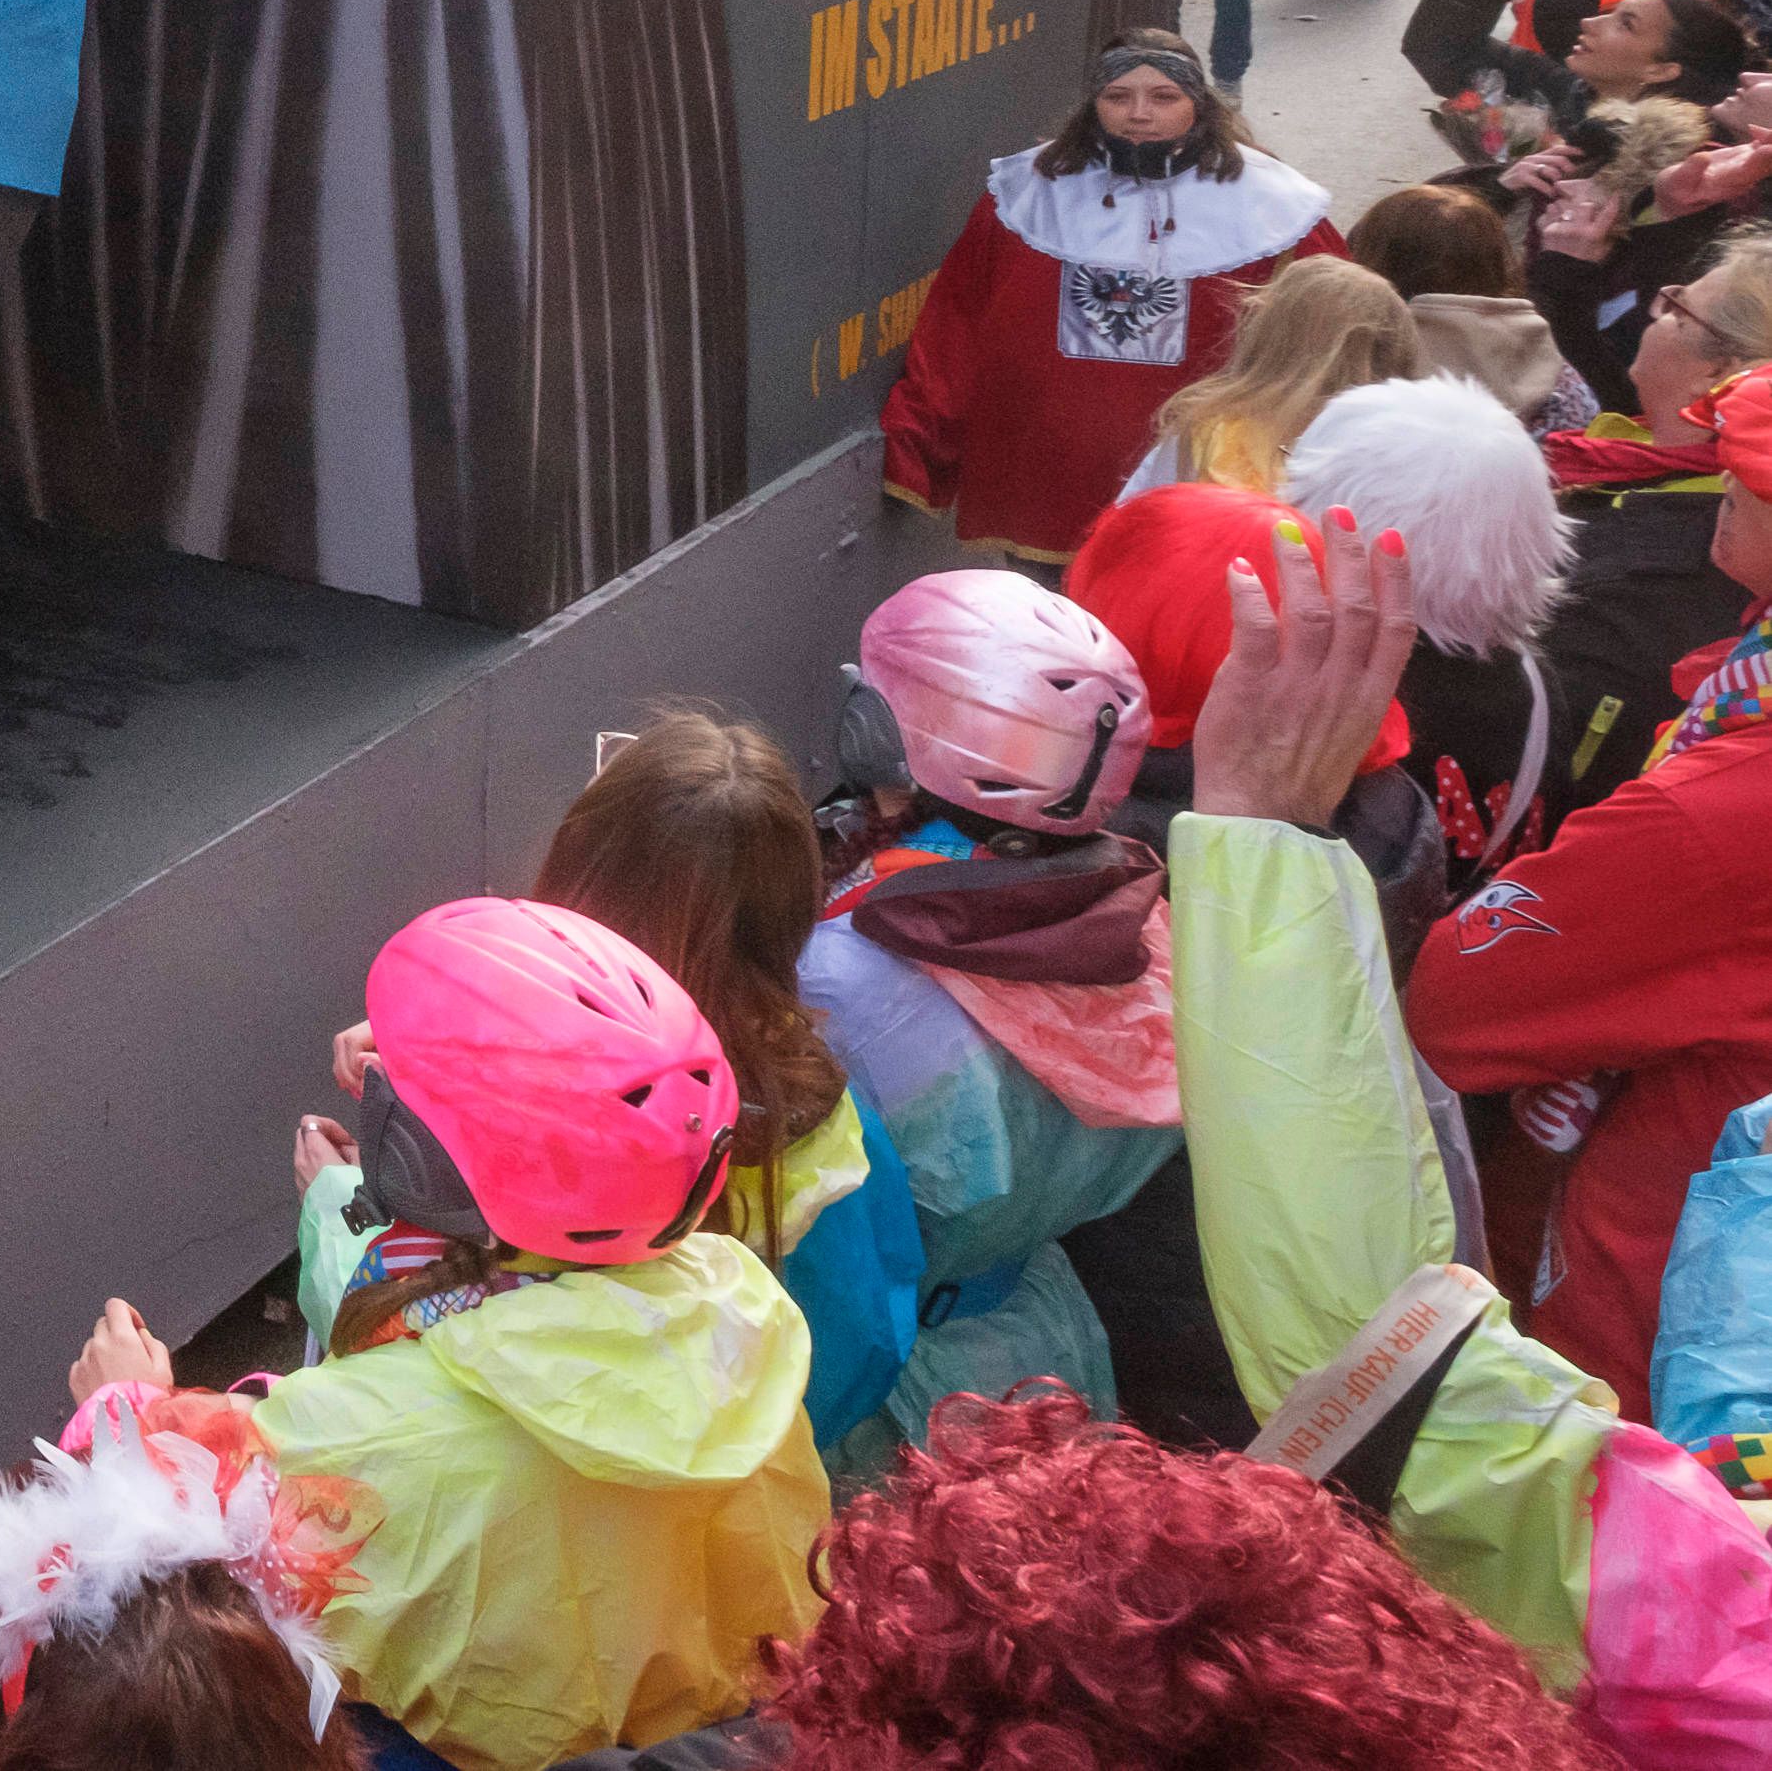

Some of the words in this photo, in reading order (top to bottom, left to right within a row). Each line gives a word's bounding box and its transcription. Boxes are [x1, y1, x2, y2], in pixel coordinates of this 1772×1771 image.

[1385, 1299, 1442, 1354] HIER
[1342, 1346, 1398, 1405] KAUF
[1310, 1395, 1354, 1436] ICH
[1278, 1426, 1325, 1467] EIN
